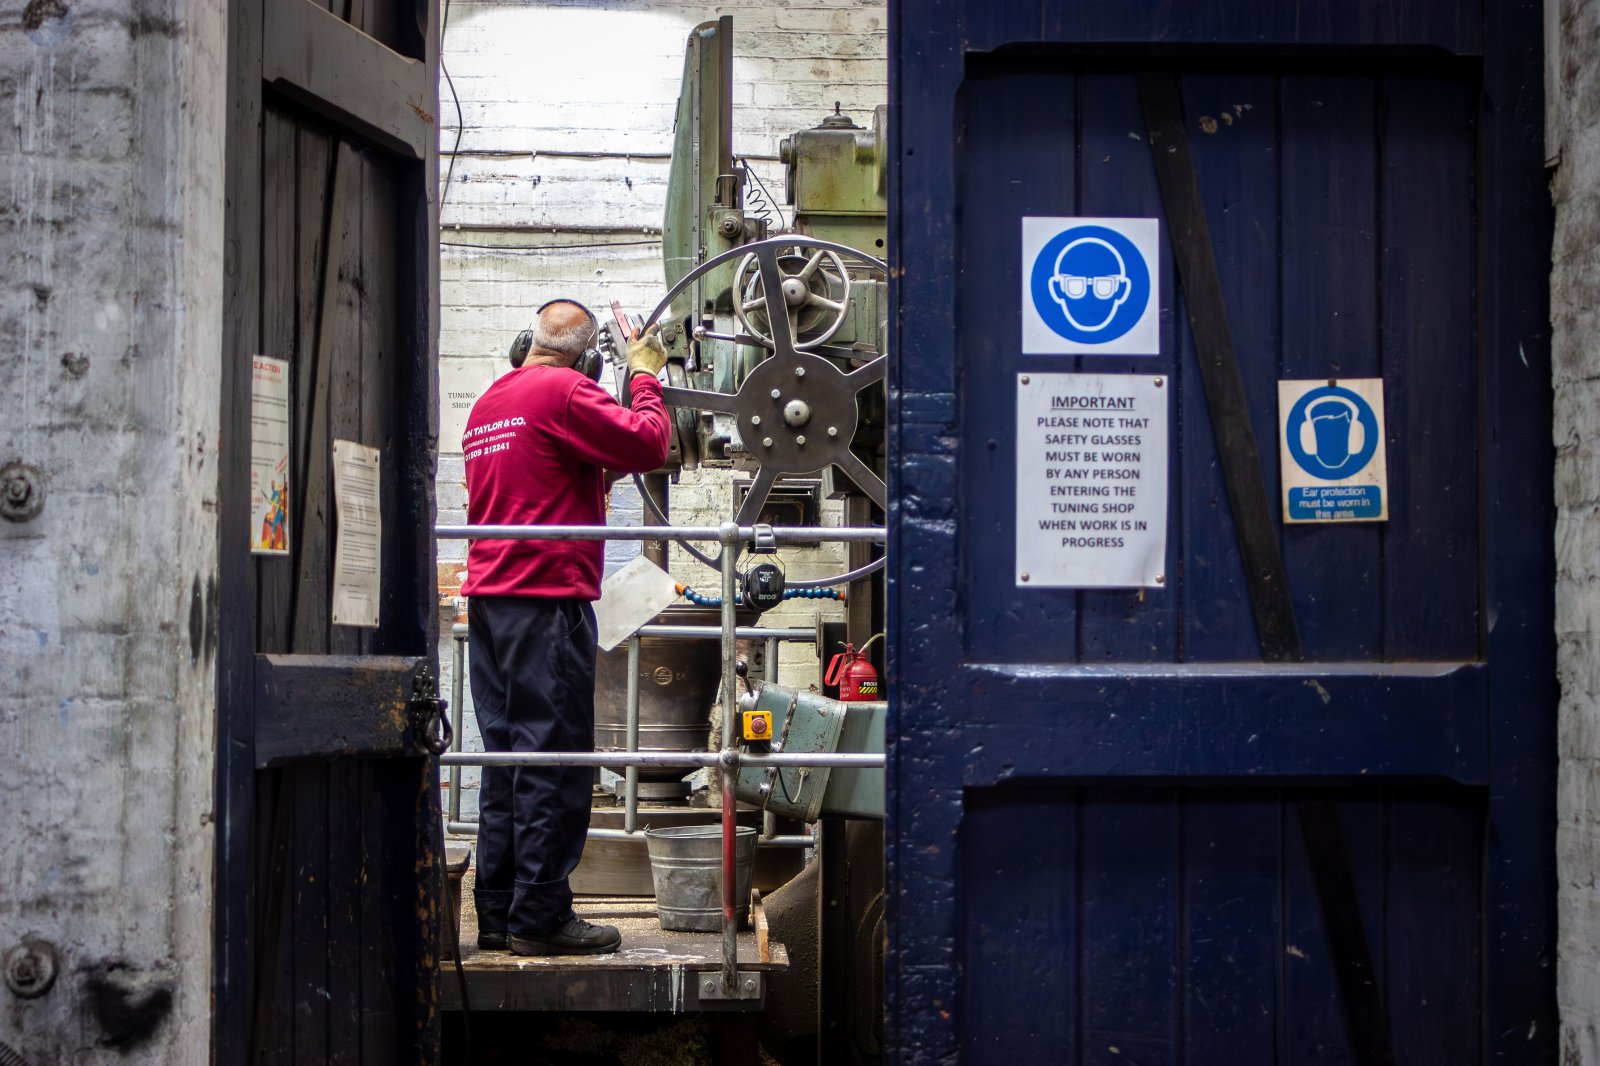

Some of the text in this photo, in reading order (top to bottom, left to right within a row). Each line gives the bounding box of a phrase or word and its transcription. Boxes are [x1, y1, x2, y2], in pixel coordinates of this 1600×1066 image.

[1051, 396, 1135, 408] IMPORTANT
[474, 421, 503, 435] TAYLOR
[504, 419, 510, 427] &
[511, 417, 526, 425] CO.
[1037, 417, 1149, 428] PLEASE NOTE THAT
[1045, 434, 1141, 445] SAFETY GLASSES
[484, 442, 510, 454] 212241
[1046, 452, 1141, 462] MUST BE WORN
[1046, 469, 1140, 479] BY ANY PERSON
[1050, 486, 1136, 496] ENTERING THE
[1302, 487, 1366, 498] Ear protection
[1052, 503, 1135, 513] TUNING SHOP
[1299, 498, 1370, 508] must be worn in
[1315, 510, 1355, 518] this area
[1039, 520, 1147, 530] WHEN WORK IS IN
[1062, 537, 1124, 547] PROGRESS
